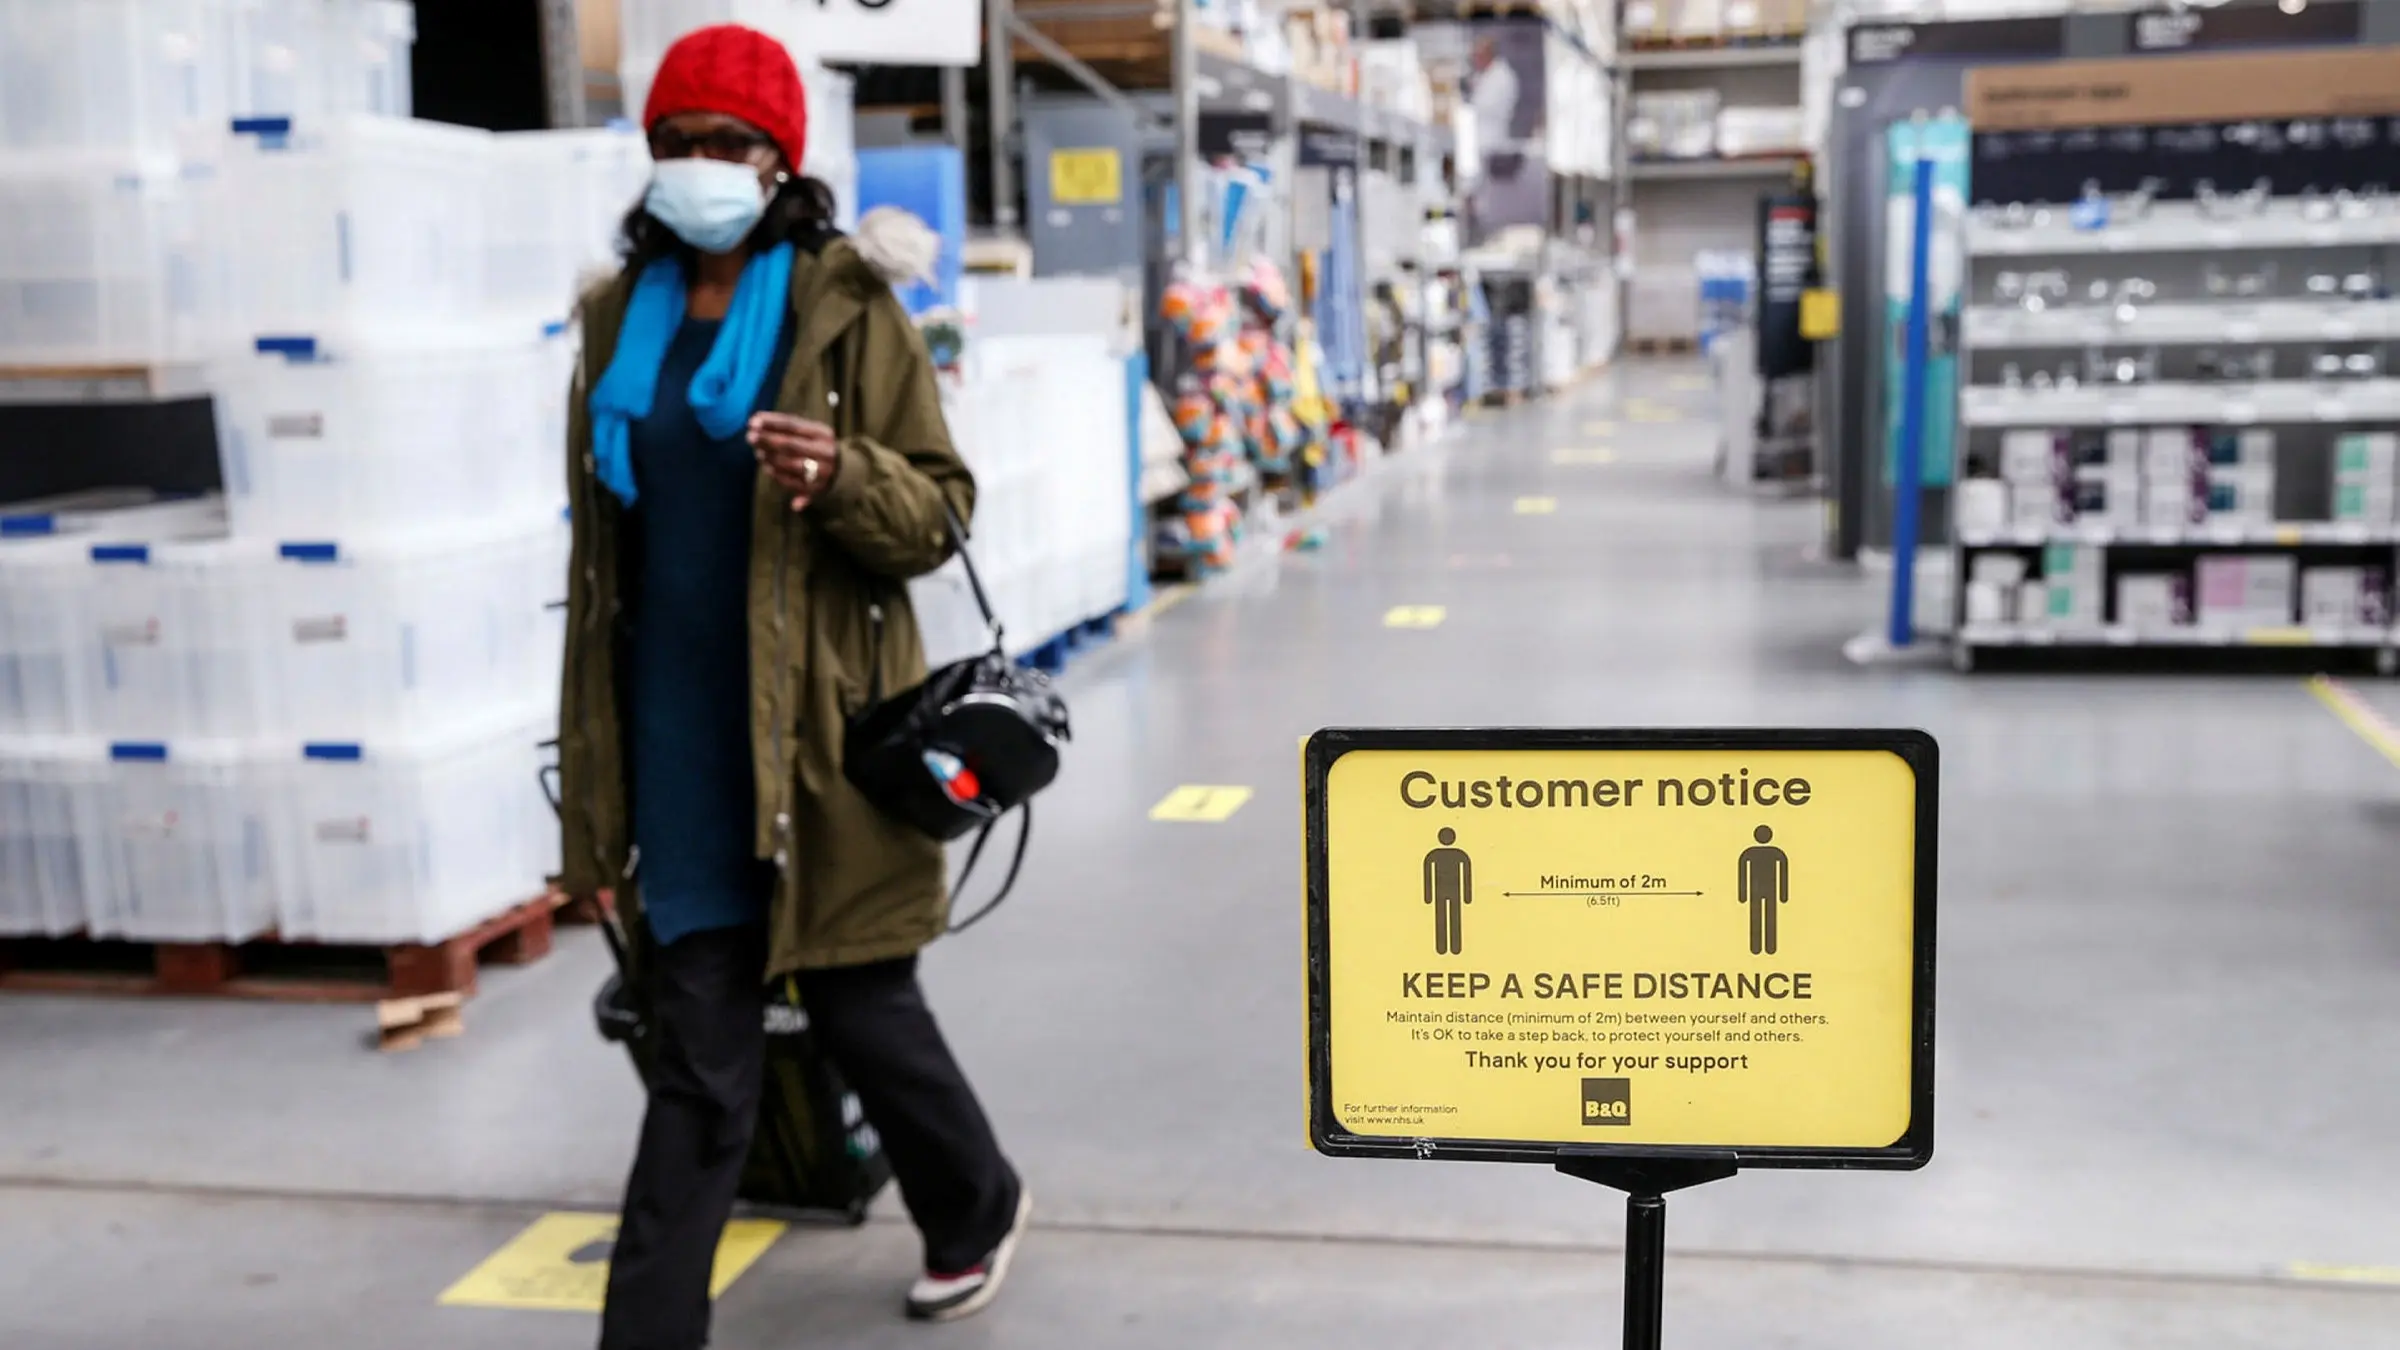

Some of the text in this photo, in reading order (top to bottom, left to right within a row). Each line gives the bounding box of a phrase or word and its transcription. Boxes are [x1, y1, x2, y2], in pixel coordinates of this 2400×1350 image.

[1400, 767, 1812, 810] Customer notice
[1540, 875, 1667, 889] Minimum of 2m
[1586, 896, 1620, 907] (6.5ft)
[1402, 973, 1812, 1000] KEEP A SAFE DISTANCE
[1386, 1011, 1830, 1027] Maintain distance (minimum of 2m) between yourself and others.
[1433, 1029, 1454, 1041] OK
[1458, 1030, 1472, 1041] to
[1475, 1029, 1504, 1041] take
[1508, 1032, 1516, 1041] a
[1519, 1030, 1549, 1044] step
[1592, 1031, 1606, 1042] to
[1609, 1031, 1660, 1044] protect
[1664, 1030, 1721, 1044] yourself
[1724, 1030, 1751, 1042] and
[1754, 1031, 1804, 1043] others.
[1465, 1051, 1749, 1075] Thank you for your support
[1344, 1103, 1458, 1114] For further information
[1585, 1100, 1628, 1118] B&Q
[1344, 1115, 1425, 1125] visit www.nhs.uk
